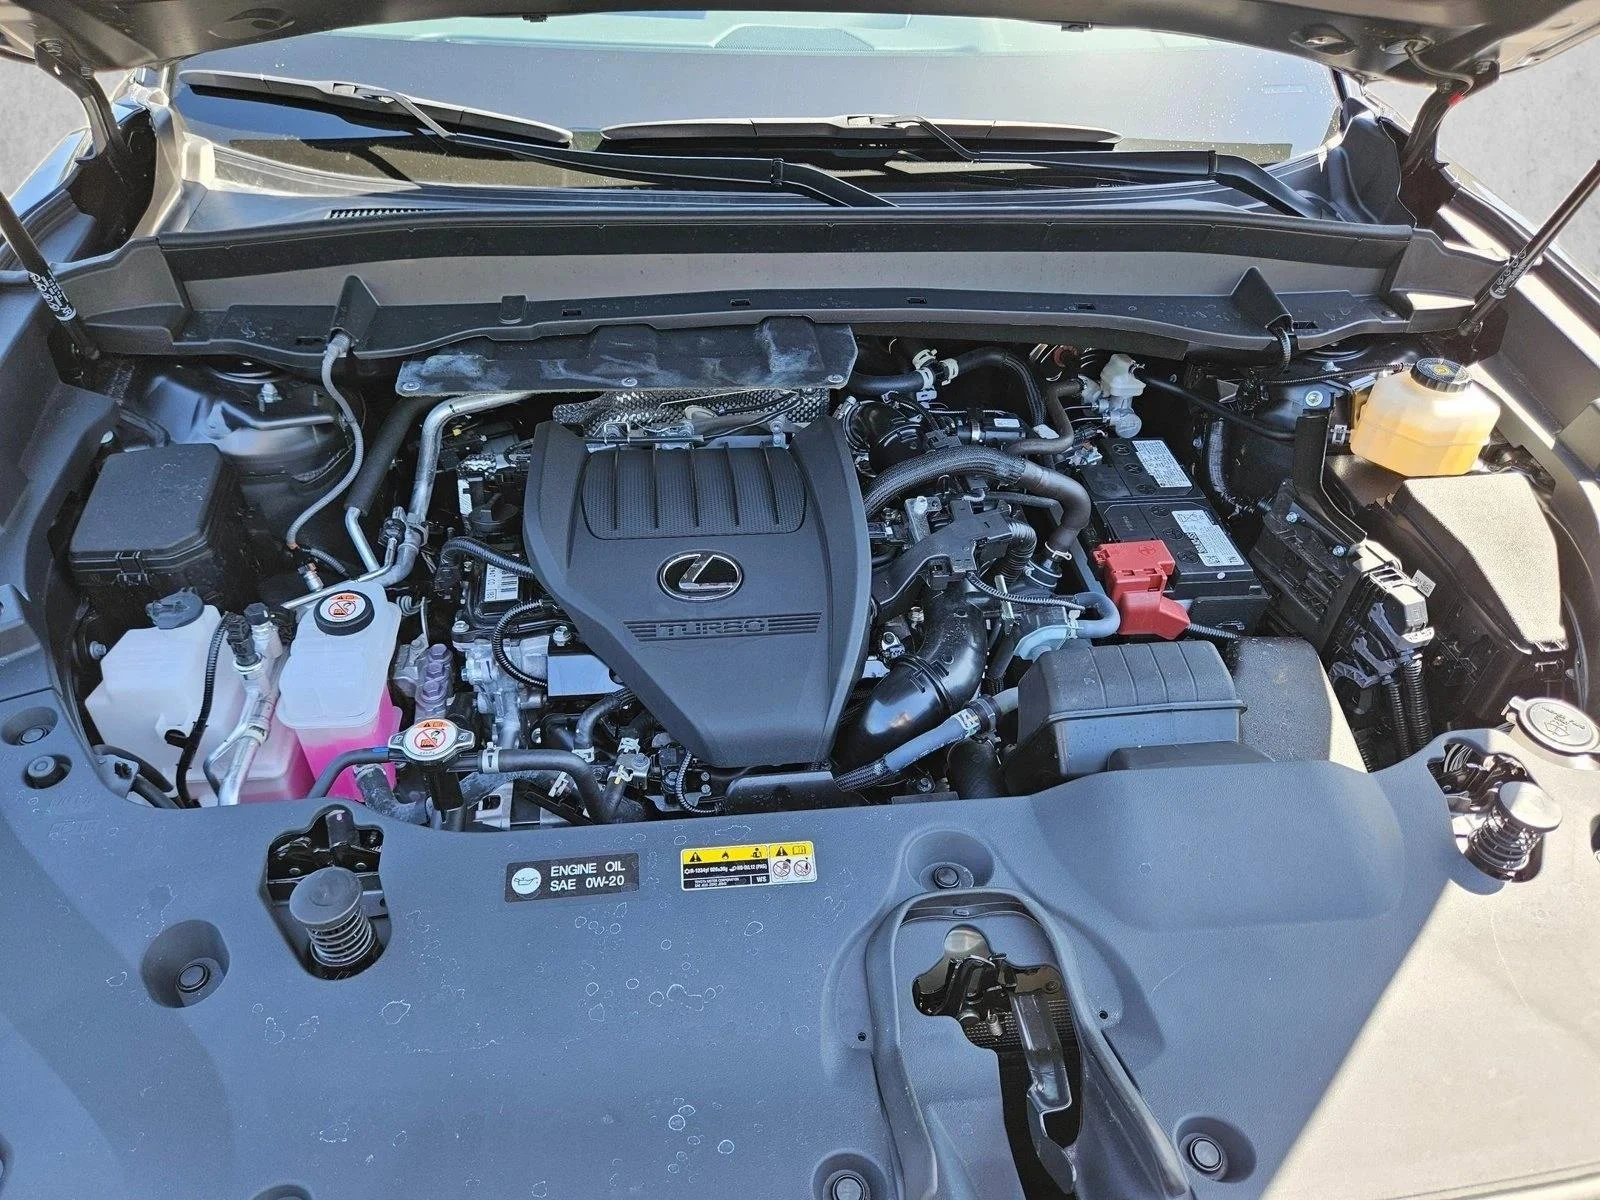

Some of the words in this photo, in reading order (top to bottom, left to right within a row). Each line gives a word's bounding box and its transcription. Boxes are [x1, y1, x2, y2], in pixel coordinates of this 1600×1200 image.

[657, 618, 767, 638] TURBO
[550, 863, 597, 877] ENGINE
[604, 860, 626, 873] OIL
[550, 878, 577, 892] SAE
[585, 875, 625, 889] 0W-20
